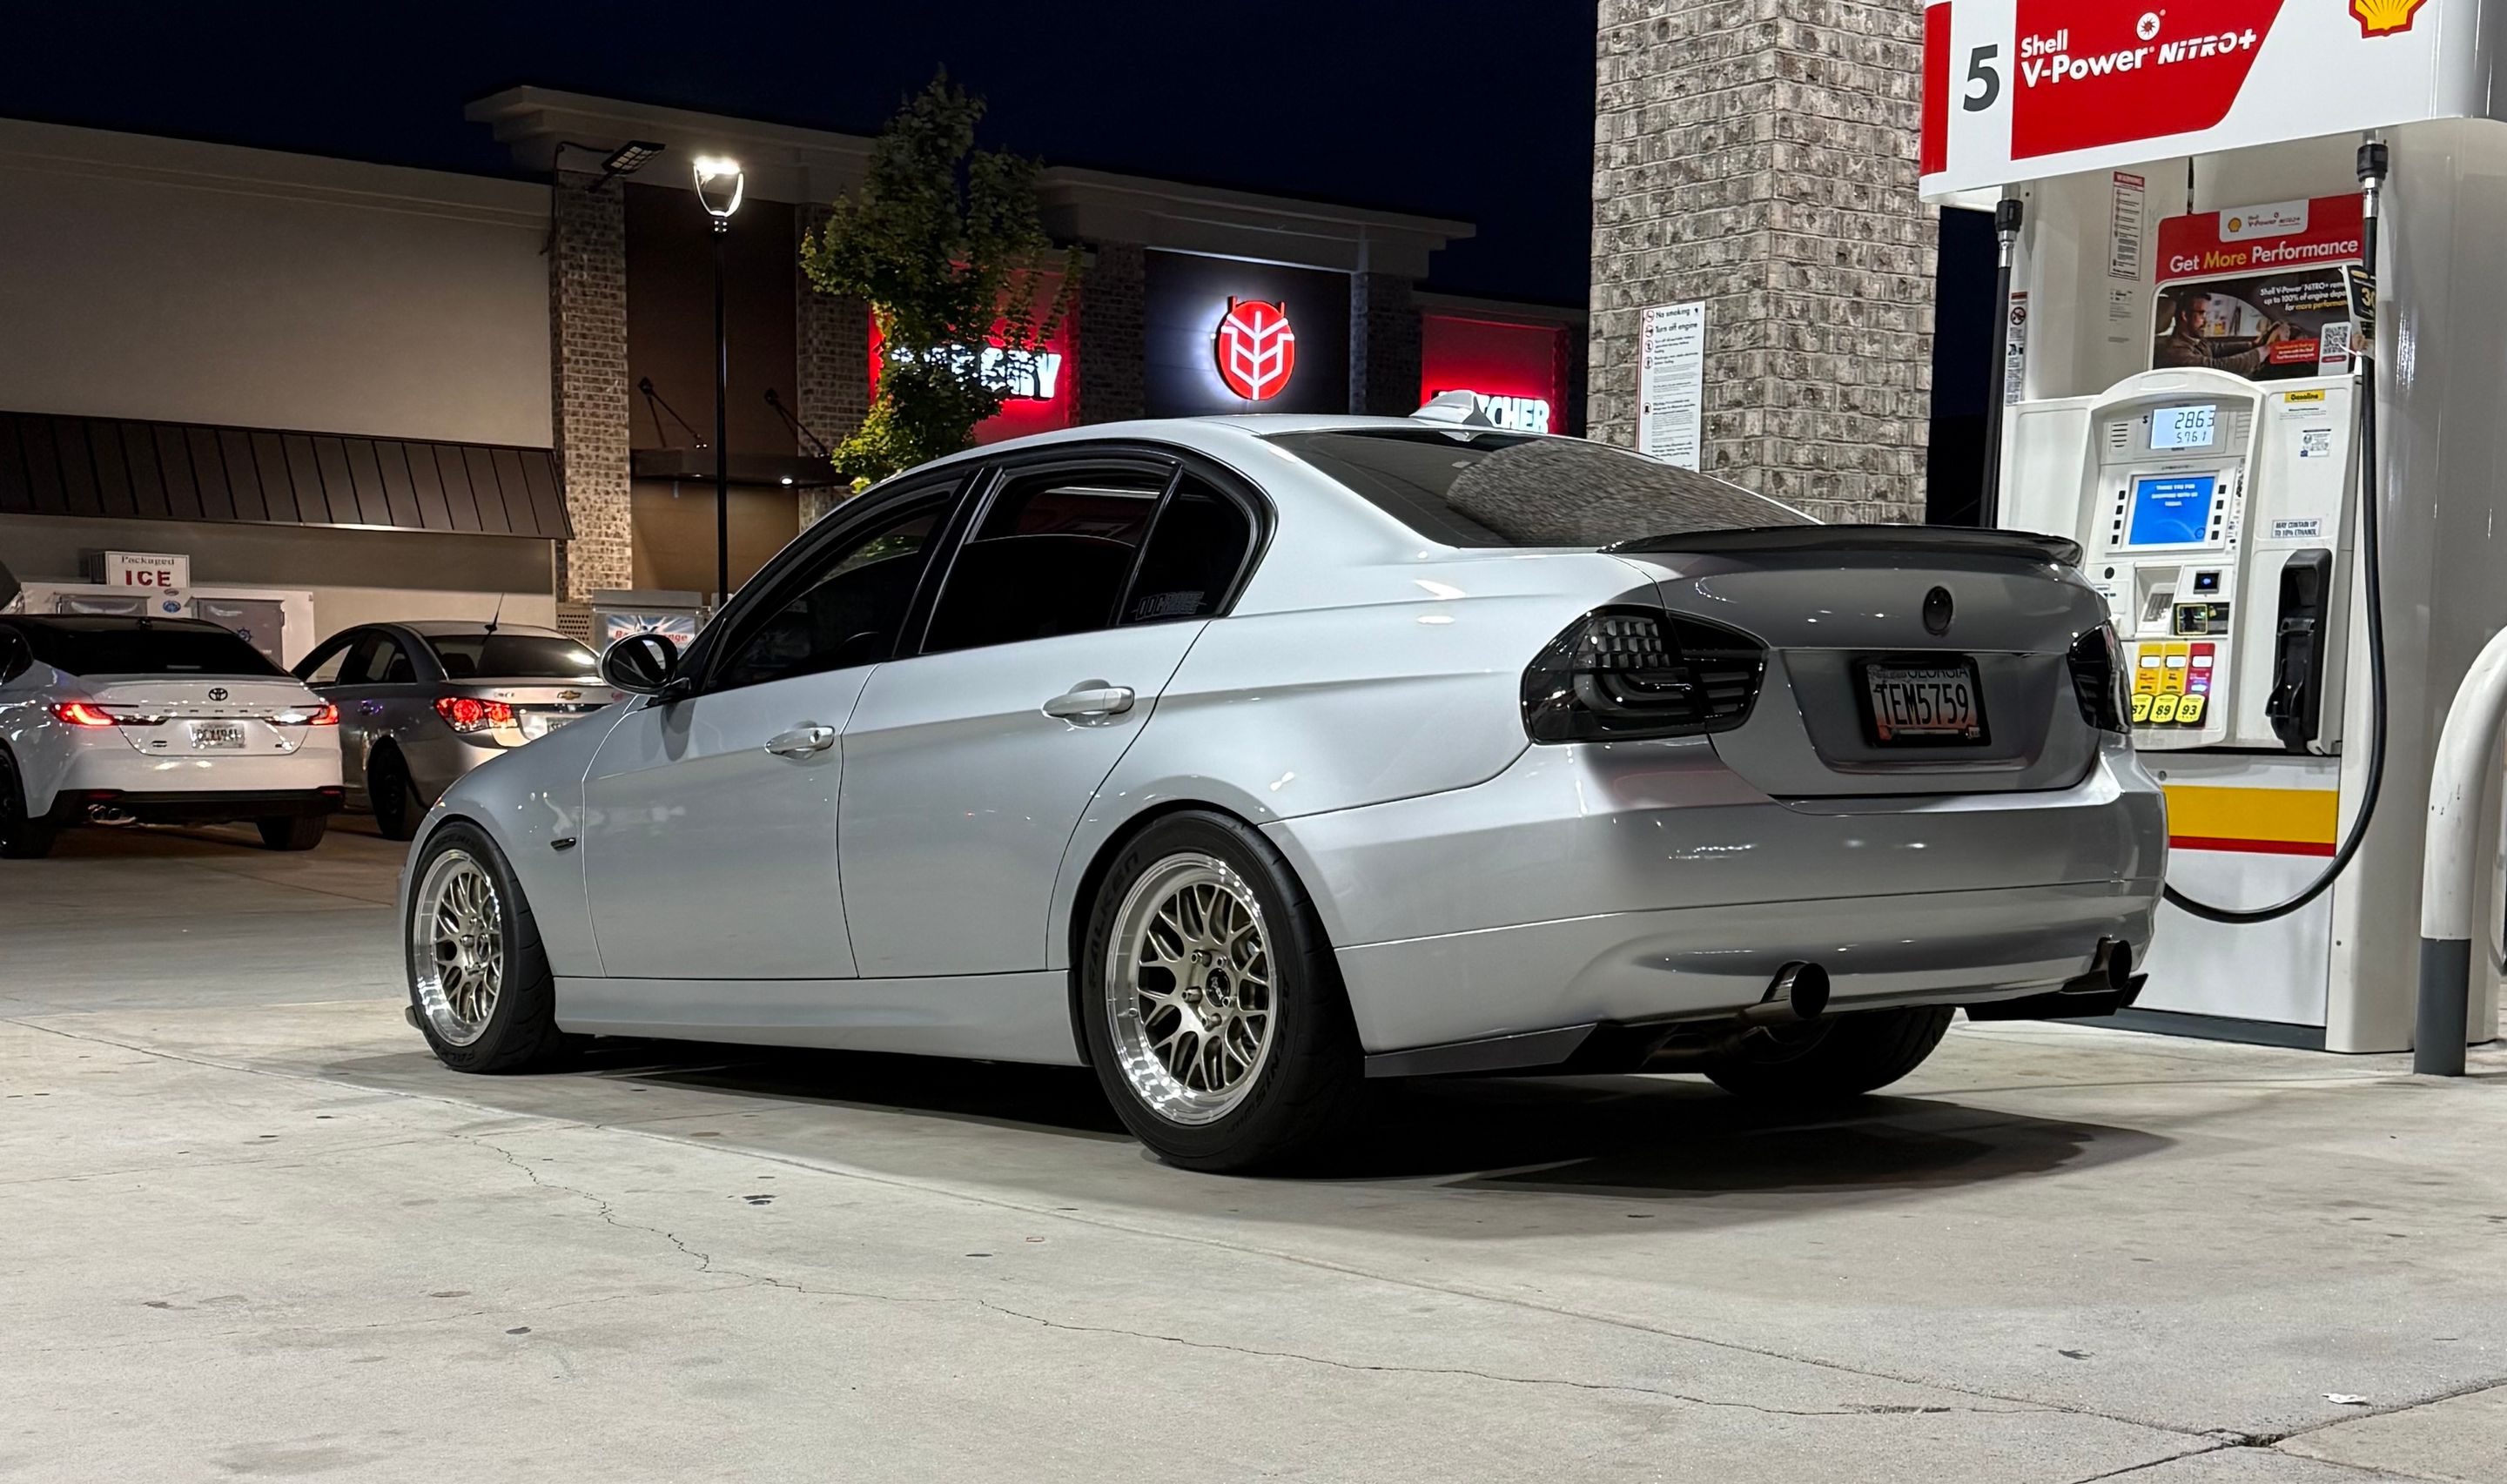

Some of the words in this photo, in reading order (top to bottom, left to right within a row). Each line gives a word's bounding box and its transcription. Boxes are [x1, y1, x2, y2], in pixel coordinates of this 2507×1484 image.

[2020, 29, 2068, 57] Shell
[2021, 47, 2148, 88] V-Power
[1963, 44, 2000, 112] 5
[2169, 256, 2200, 273] Get
[2203, 251, 2248, 270] More
[2251, 239, 2358, 264] Performance
[2260, 288, 2275, 297] Shell
[2275, 285, 2302, 295] V-Power
[2307, 292, 2329, 301] engine
[121, 556, 175, 566] Packaged
[125, 570, 171, 587] ICE
[1874, 683, 1969, 726] TEM5759
[2156, 704, 2172, 715] 89
[2181, 704, 2198, 715] 93
